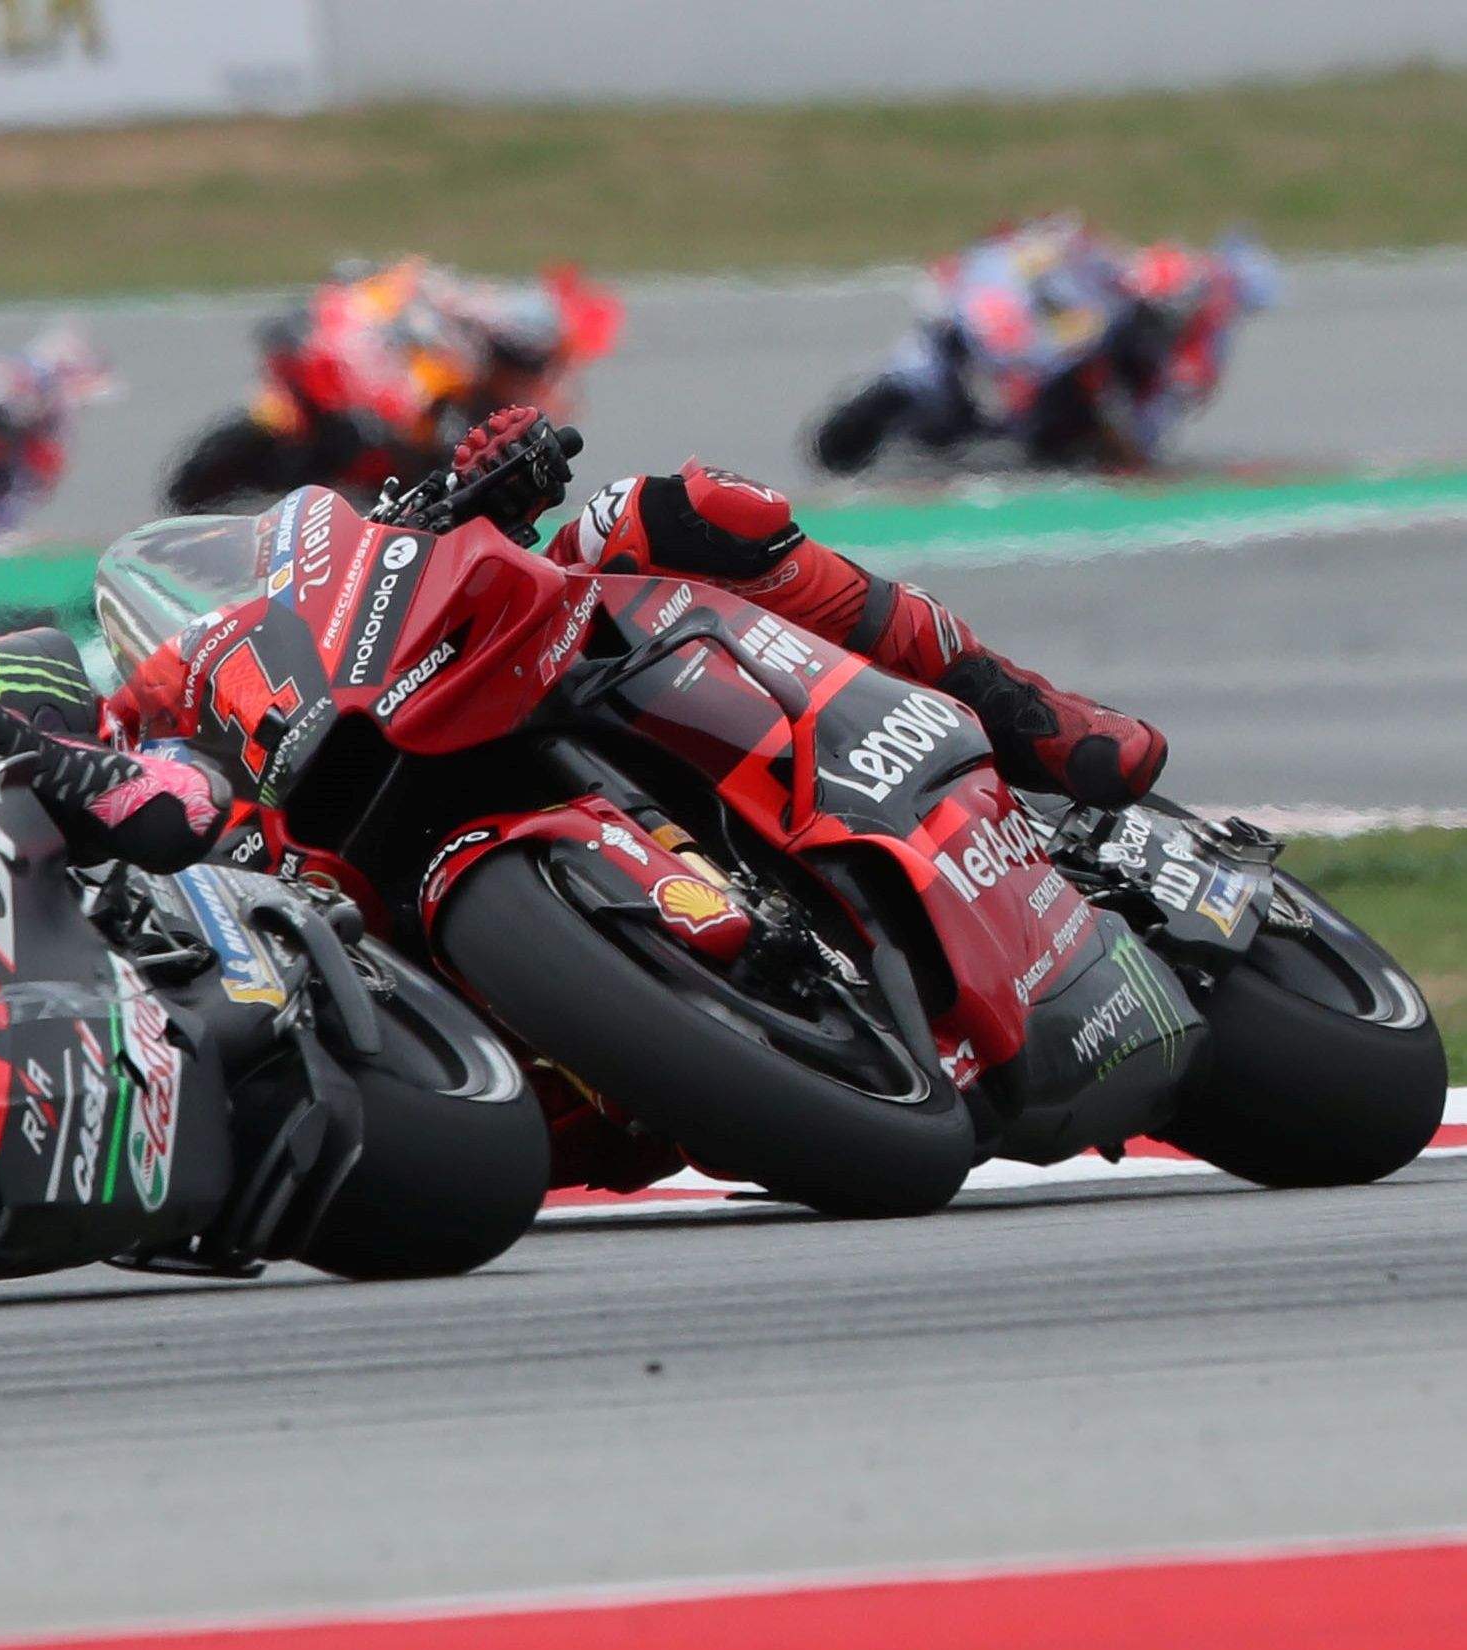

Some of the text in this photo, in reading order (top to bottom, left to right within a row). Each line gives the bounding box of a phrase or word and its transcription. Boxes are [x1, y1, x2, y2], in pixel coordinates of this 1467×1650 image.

[350, 574, 399, 685] motorola
[551, 578, 602, 662] Audi Sport
[375, 641, 456, 718] CARRERA
[267, 696, 332, 784] MONSTER
[819, 692, 961, 804] Lenovo
[1071, 982, 1141, 1064] MONSTER
[1096, 1029, 1145, 1083] ENERGY
